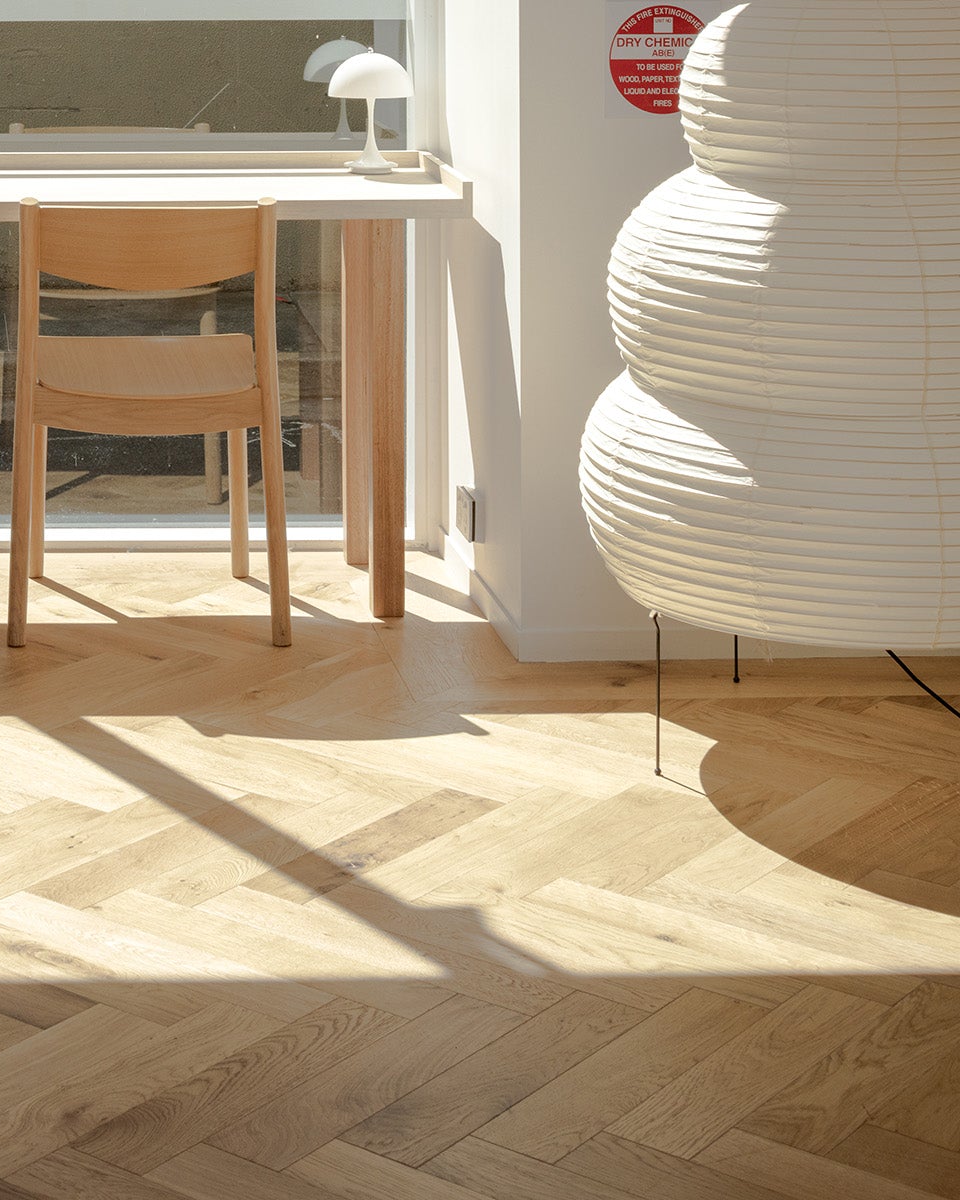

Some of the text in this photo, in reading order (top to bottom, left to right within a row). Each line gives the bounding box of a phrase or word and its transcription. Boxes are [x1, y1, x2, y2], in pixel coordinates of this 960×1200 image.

[622, 17, 637, 32] THIS
[637, 9, 653, 21] FIRE
[616, 37, 693, 48] DRY CHEMIC
[652, 49, 675, 57] AB(E)
[619, 75, 641, 83] WOOD,
[642, 75, 665, 83] PAPER,
